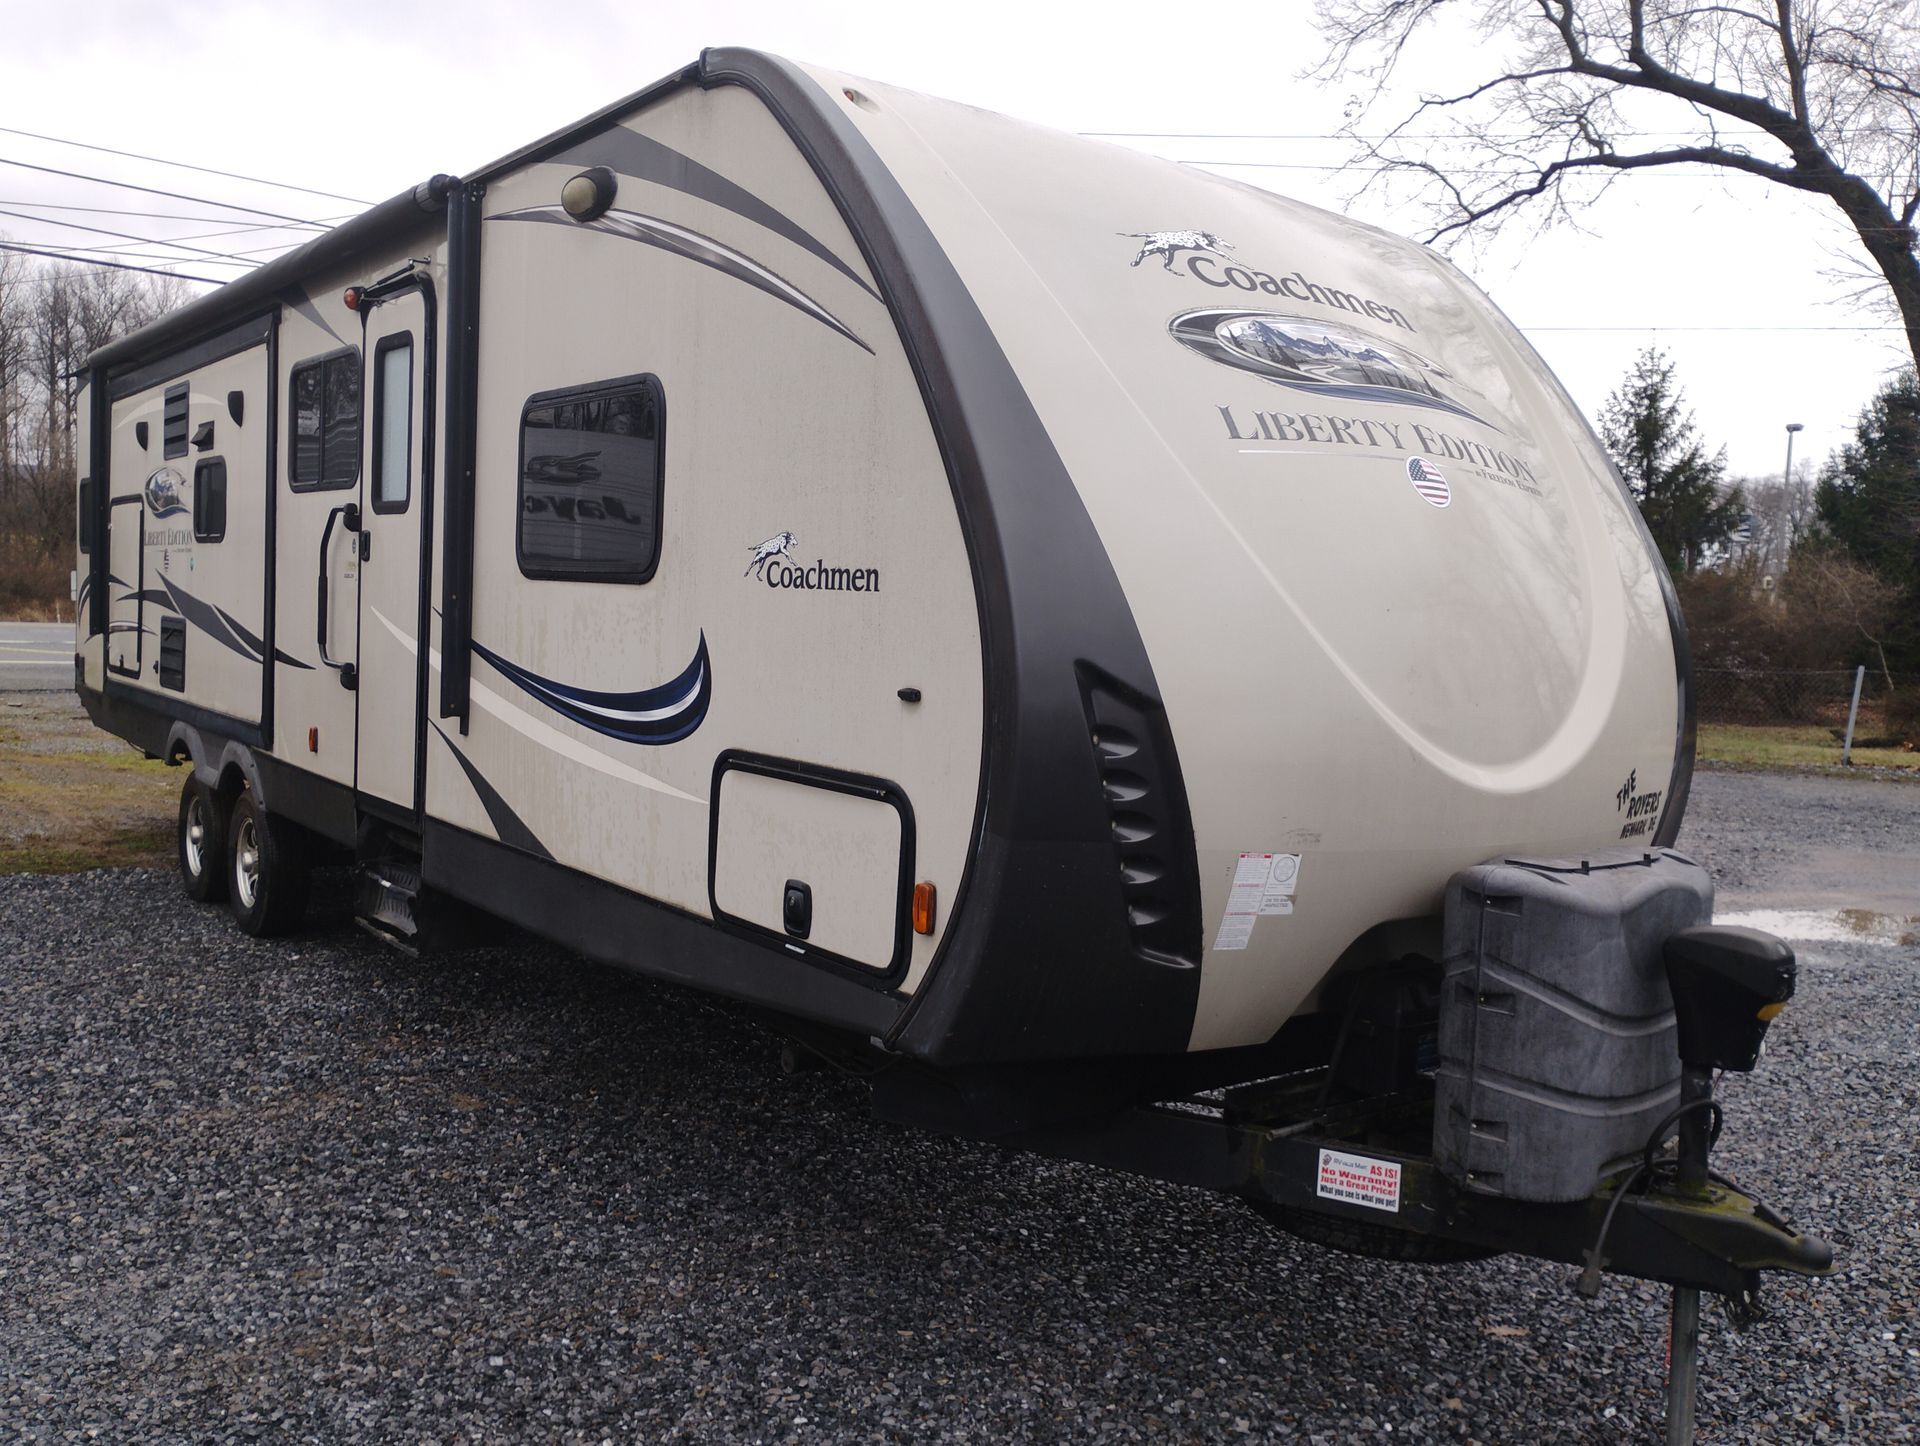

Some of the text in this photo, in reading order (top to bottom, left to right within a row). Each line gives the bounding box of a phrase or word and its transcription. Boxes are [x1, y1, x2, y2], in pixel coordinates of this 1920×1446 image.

[1187, 255, 1417, 333] Coachmen
[1214, 403, 1538, 485] LIBERTY EDITION
[766, 558, 881, 593] Coachmen
[1616, 767, 1637, 812] THE
[1320, 1175, 1337, 1185] Just
[1346, 1179, 1369, 1191] Great
[1371, 1185, 1397, 1197] Price!
[1321, 1166, 1398, 1188] No Warranty!
[1370, 1165, 1382, 1177] AS
[1384, 1167, 1398, 1180] IS!
[1320, 1184, 1334, 1194] What
[1334, 1189, 1344, 1197] you
[1345, 1190, 1354, 1199] see
[1355, 1191, 1360, 1199] is
[1361, 1192, 1374, 1203] what
[1375, 1197, 1385, 1207] you
